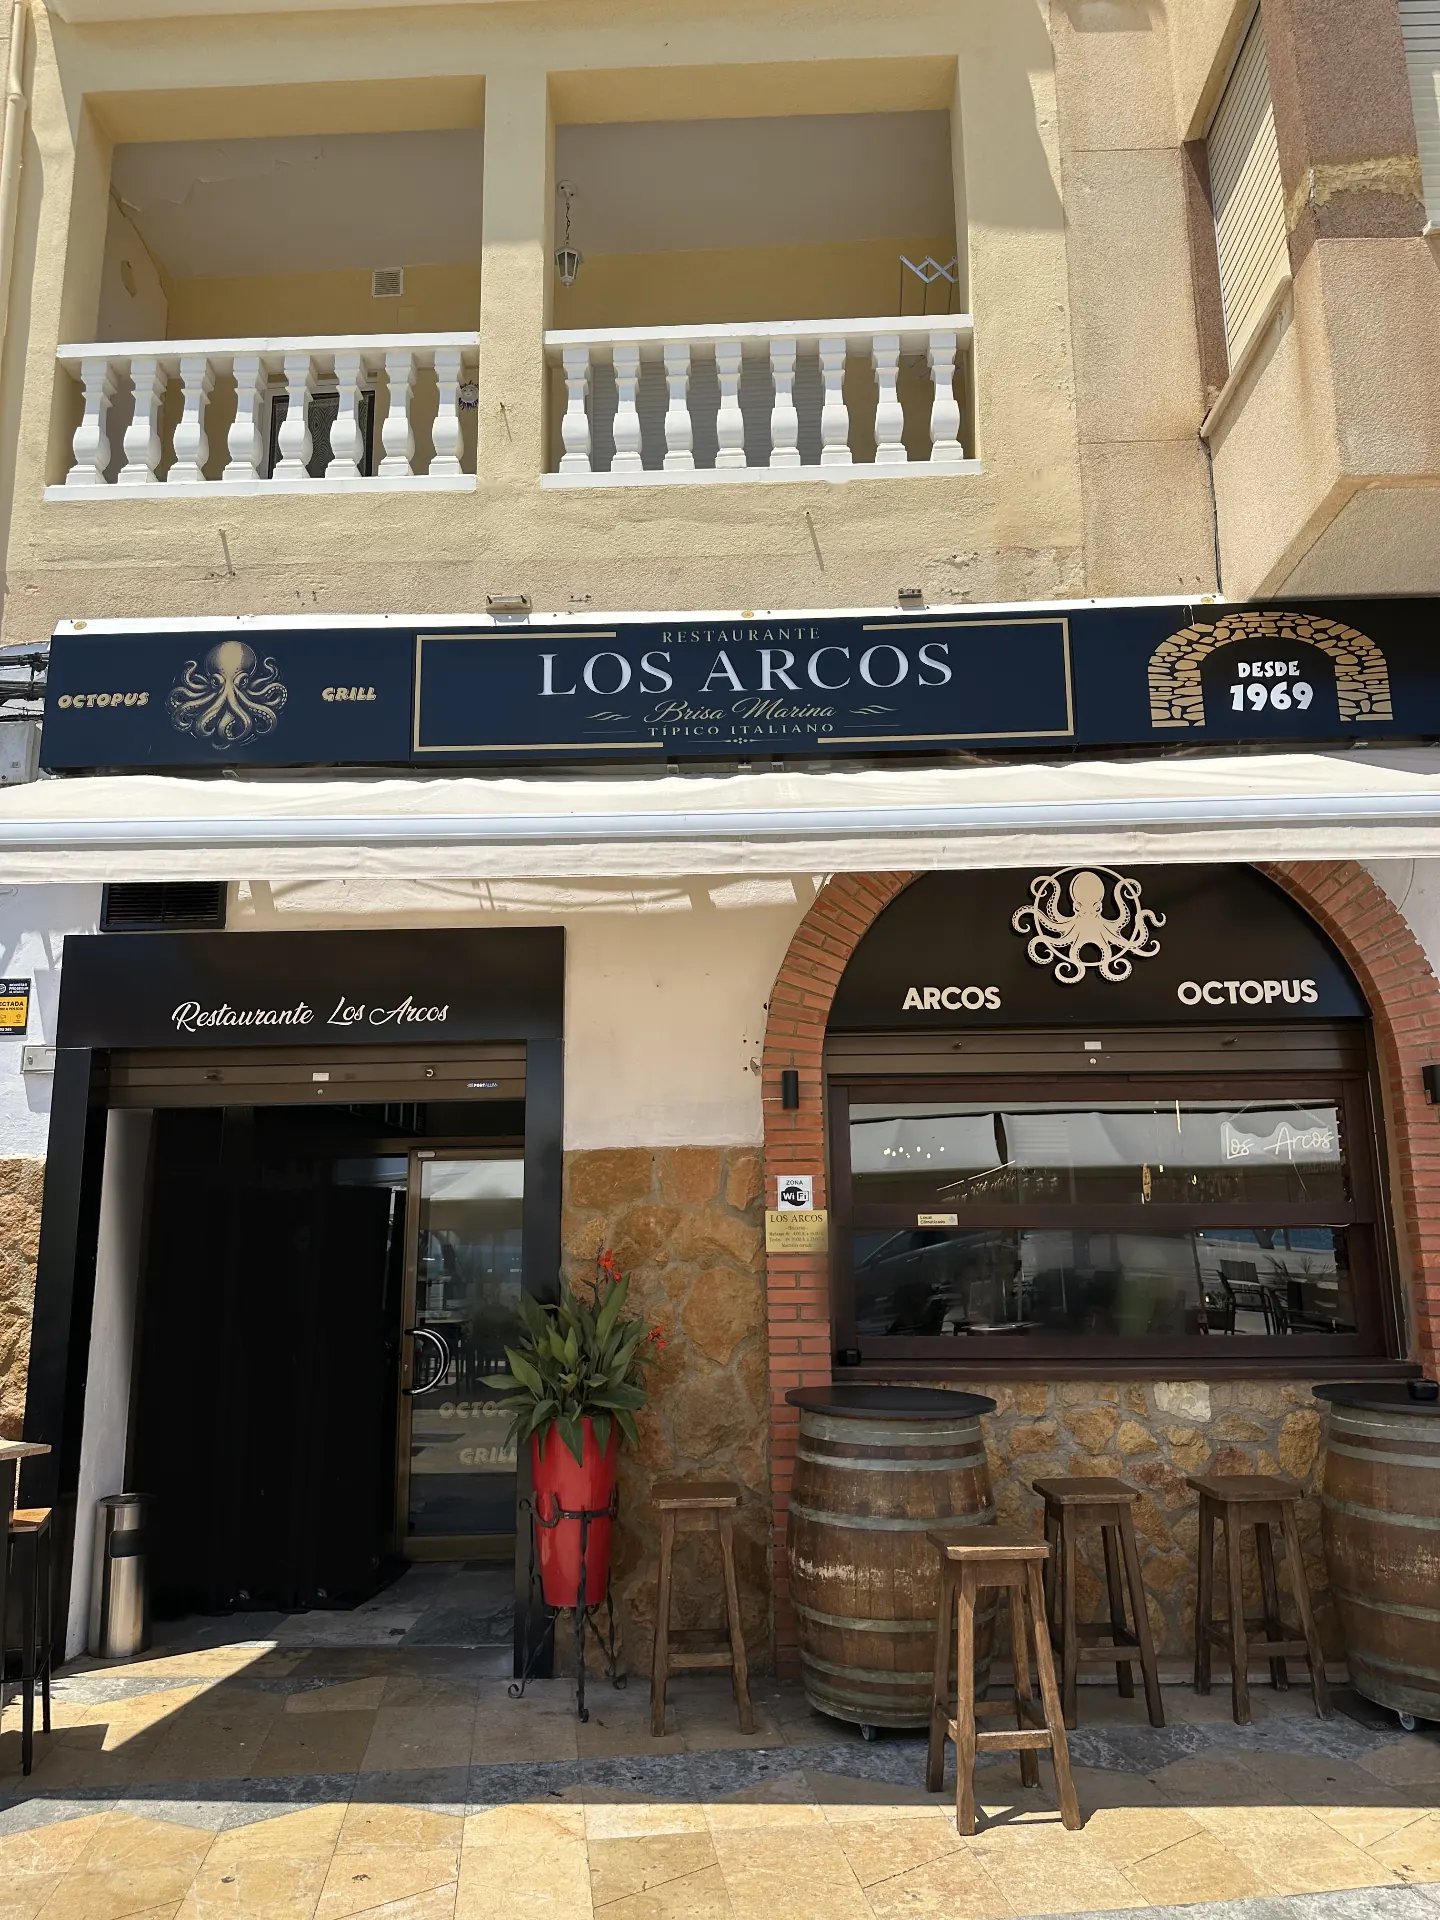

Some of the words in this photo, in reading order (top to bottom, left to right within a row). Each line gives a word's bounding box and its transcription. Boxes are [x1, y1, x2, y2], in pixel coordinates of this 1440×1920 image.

[662, 628, 820, 643] RESTAURANTE
[537, 650, 673, 697] LOS
[698, 642, 952, 692] ARCOS
[1237, 660, 1300, 678] DESDE
[58, 691, 149, 709] OCTOPUS
[321, 686, 377, 703] GRILL
[1229, 681, 1314, 712] 1969
[643, 700, 727, 723] Brisa
[731, 697, 836, 720] Marina
[648, 725, 720, 737] TÍPICO
[731, 723, 834, 735] ITALIANO
[902, 986, 1002, 1010] ARCOS
[1177, 979, 1319, 1006] OCTOPUS
[171, 1001, 315, 1033] Restaurante
[326, 996, 366, 1026] Los
[368, 995, 449, 1025] Arcos
[1226, 1126, 1255, 1159] Los
[1264, 1126, 1335, 1160] Arcos
[770, 1214, 788, 1223] LOS
[791, 1214, 823, 1223] ARCOS
[439, 1401, 518, 1418] OCTO
